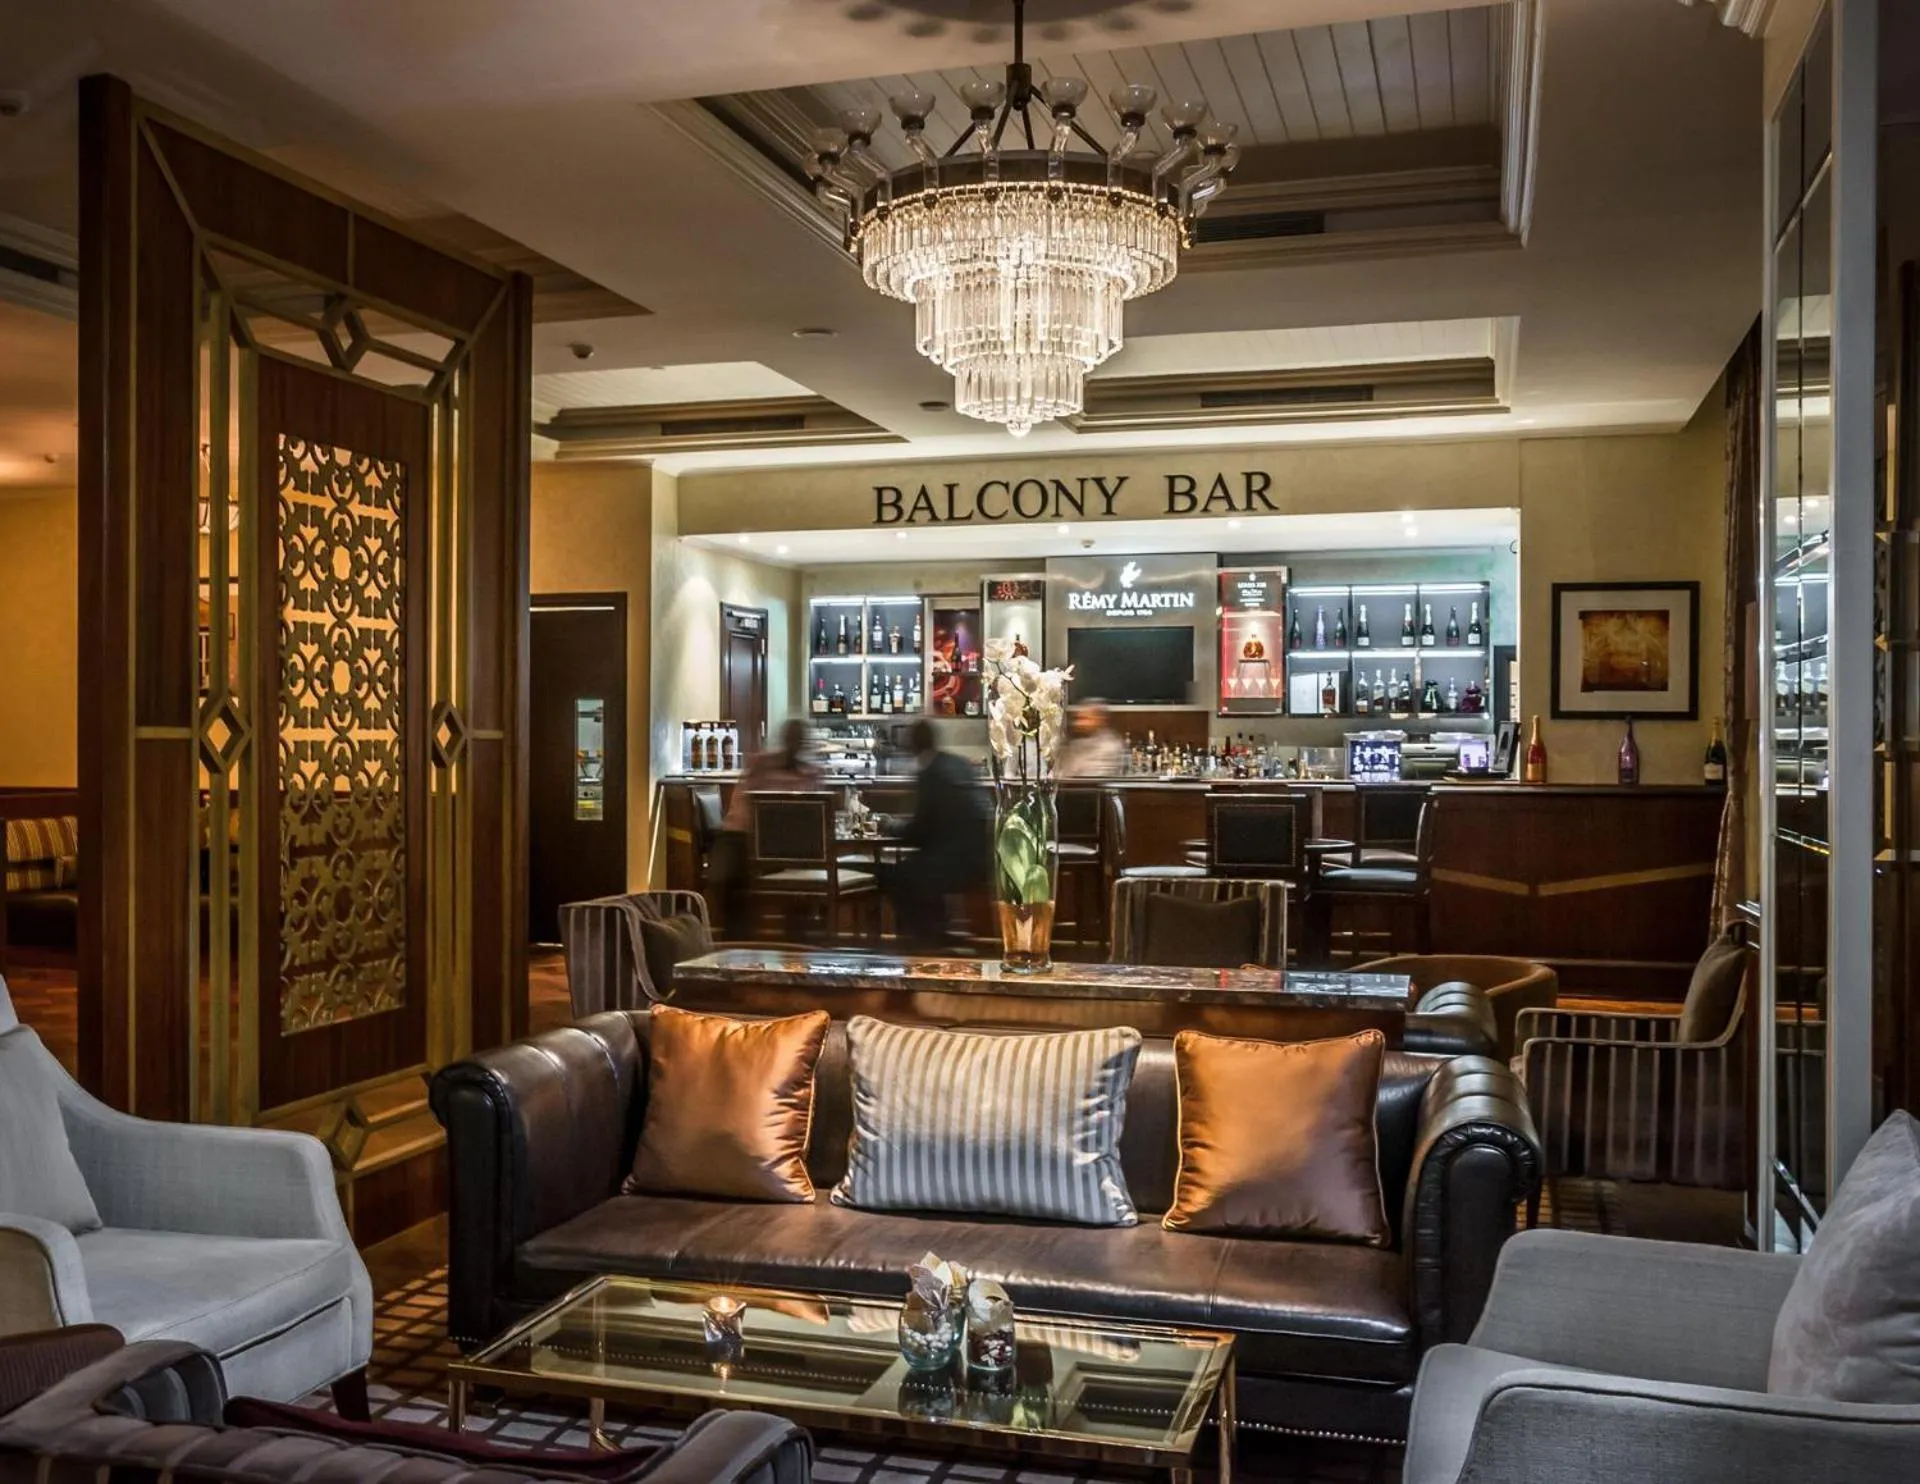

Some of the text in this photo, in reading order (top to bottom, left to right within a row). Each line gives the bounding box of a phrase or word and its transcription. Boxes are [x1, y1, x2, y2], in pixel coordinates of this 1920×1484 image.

[872, 471, 1279, 525] BALCONY BAR
[1068, 592, 1195, 610] RÉMY MARTIN
